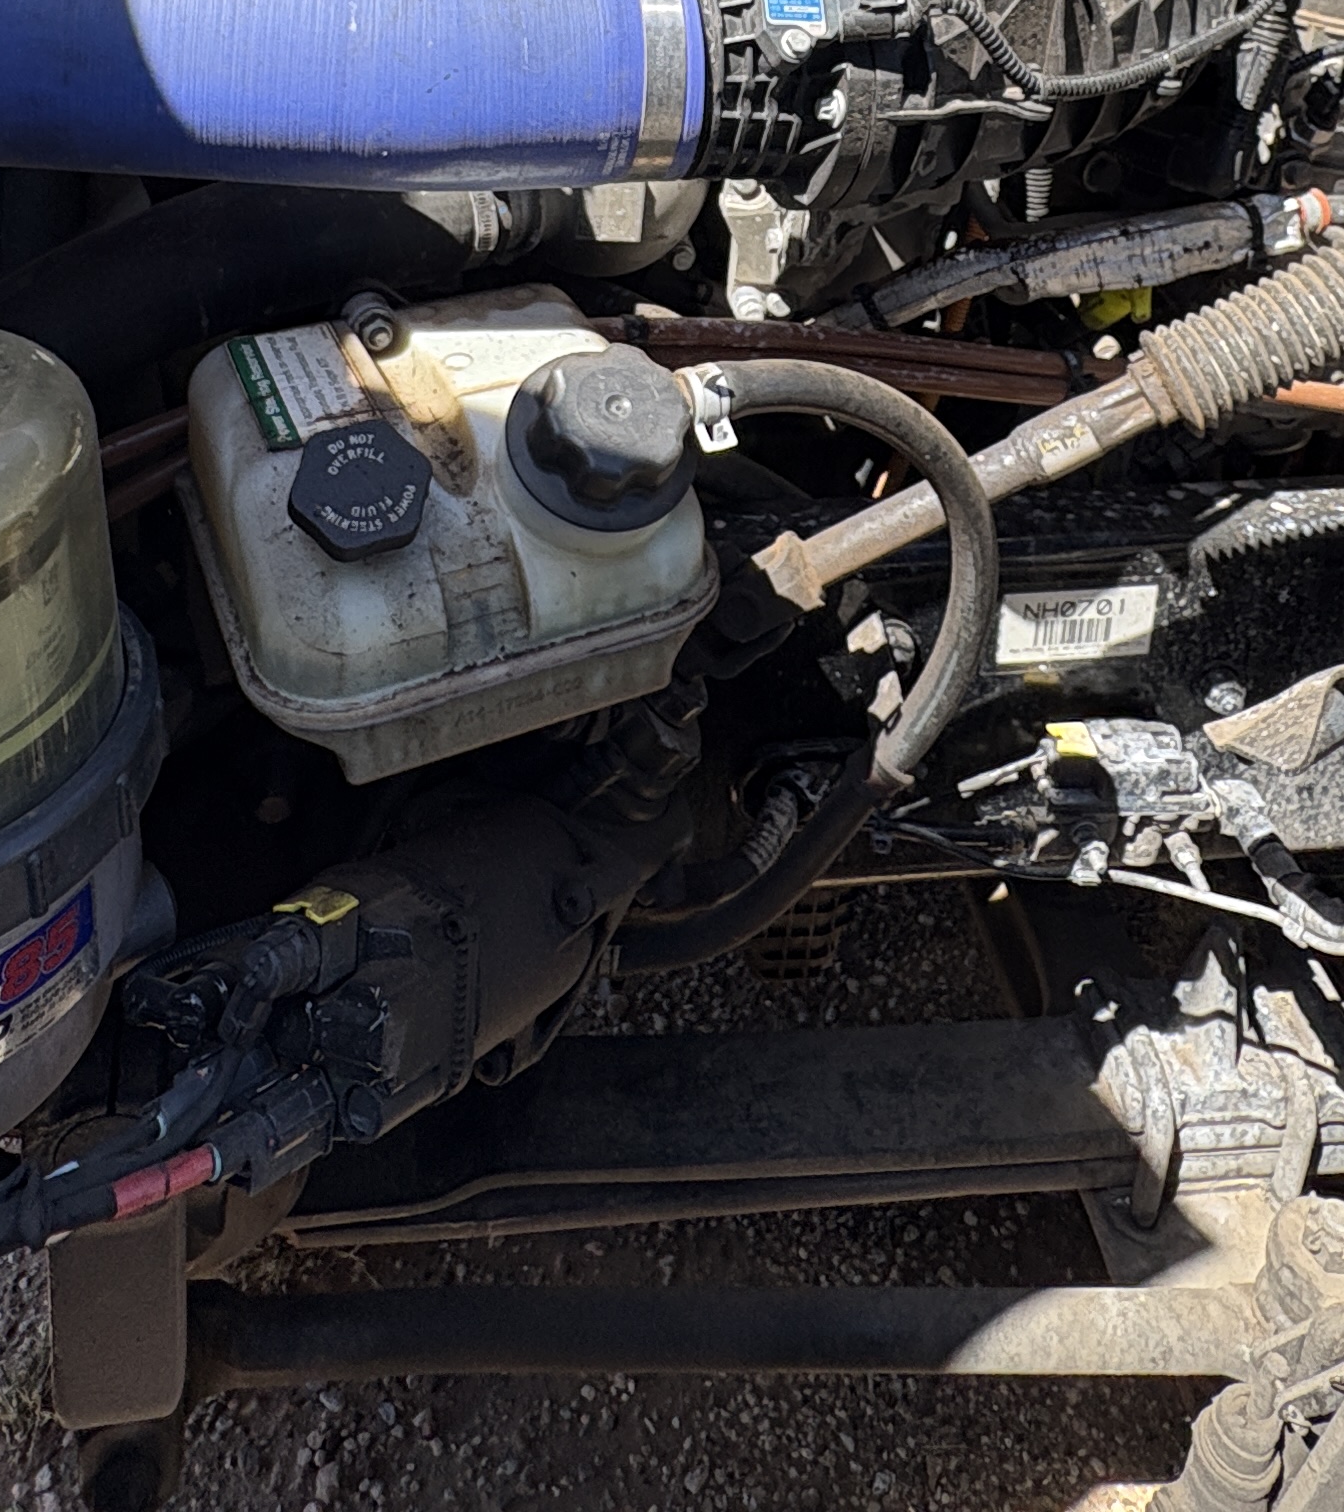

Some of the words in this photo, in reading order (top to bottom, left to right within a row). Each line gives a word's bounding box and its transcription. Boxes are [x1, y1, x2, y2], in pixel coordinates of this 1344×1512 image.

[327, 440, 345, 455] DO
[349, 434, 375, 444] NOT
[327, 447, 385, 475] OVERFILL
[351, 496, 393, 517] FLUID
[388, 484, 416, 523] POWER
[321, 505, 384, 532] STEERING
